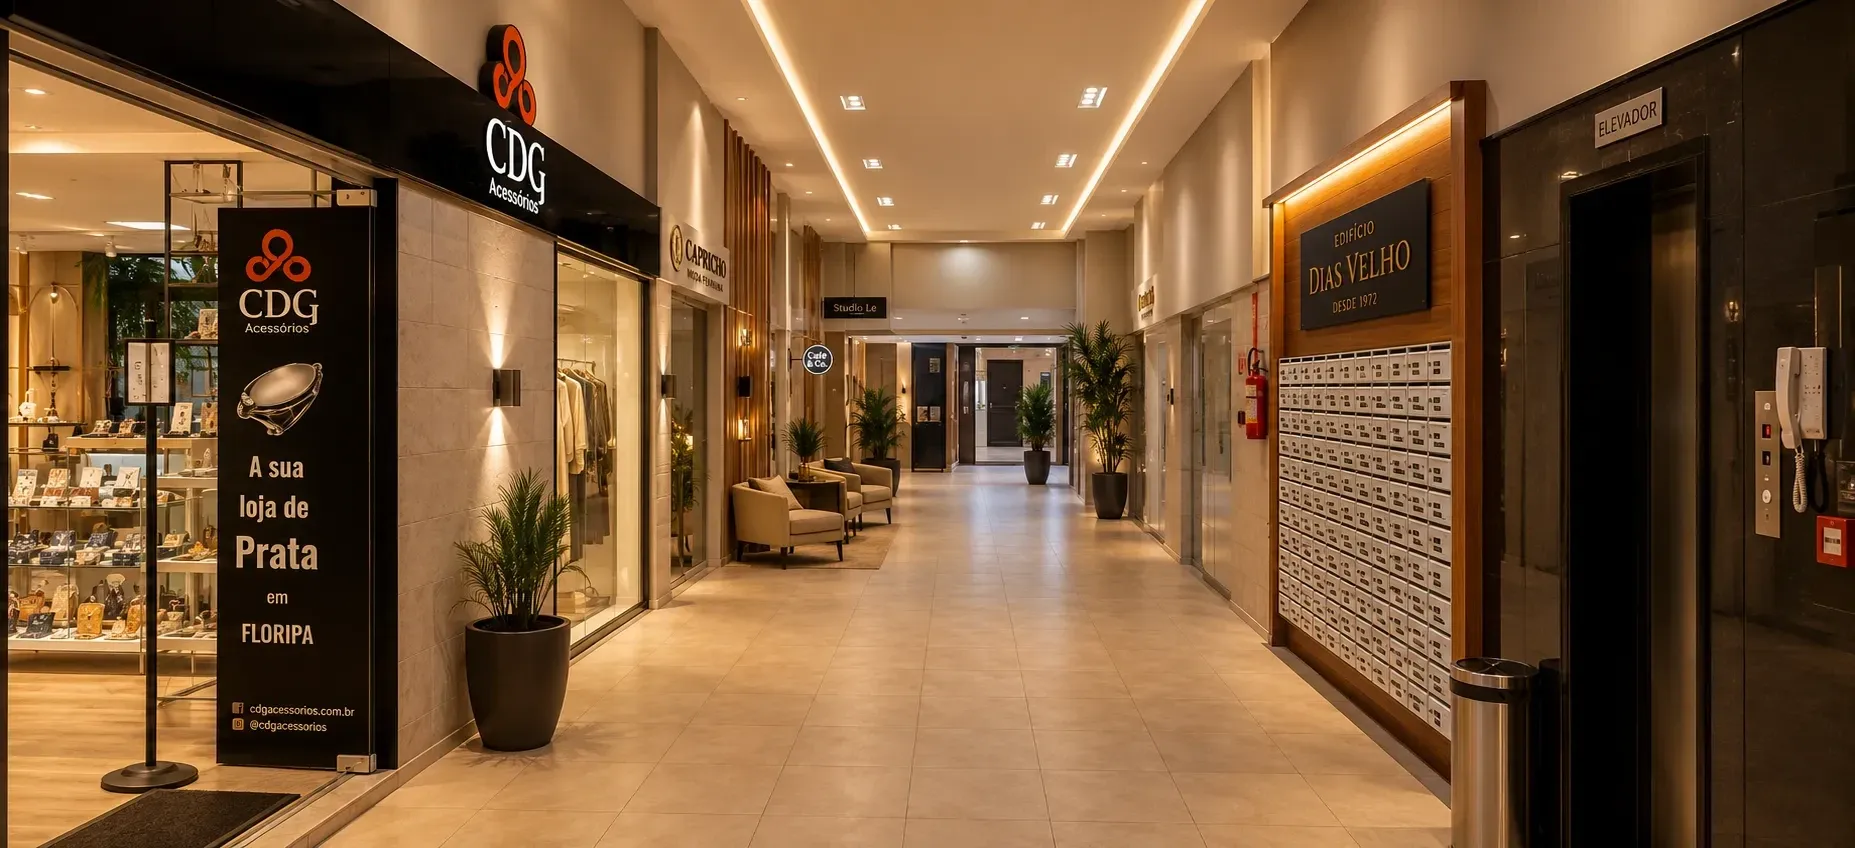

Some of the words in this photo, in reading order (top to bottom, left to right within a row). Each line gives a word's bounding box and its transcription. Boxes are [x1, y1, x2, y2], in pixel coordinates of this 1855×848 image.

[1599, 101, 1657, 137] ELEVADOR
[486, 118, 546, 206] CDG
[489, 177, 539, 214] Acessórios
[1334, 220, 1375, 248] EDIFÍCIO
[685, 239, 727, 278] CAPRICHO
[1309, 261, 1342, 295] DIAS
[1346, 239, 1411, 284] VELHO
[239, 288, 319, 326] CDG
[865, 303, 877, 312] Le
[1332, 297, 1357, 314] DESDE
[1359, 292, 1378, 308] 1972
[245, 322, 309, 334] Acessórios
[249, 455, 262, 478] A
[268, 460, 304, 478] sua
[239, 494, 277, 523] loja
[283, 495, 309, 519] de
[236, 535, 318, 570] Prata
[266, 592, 288, 605] em
[241, 623, 314, 645] FLORIPA
[249, 704, 355, 717] cdgacessorios.com.br
[249, 719, 327, 732] @cdgacessorios
